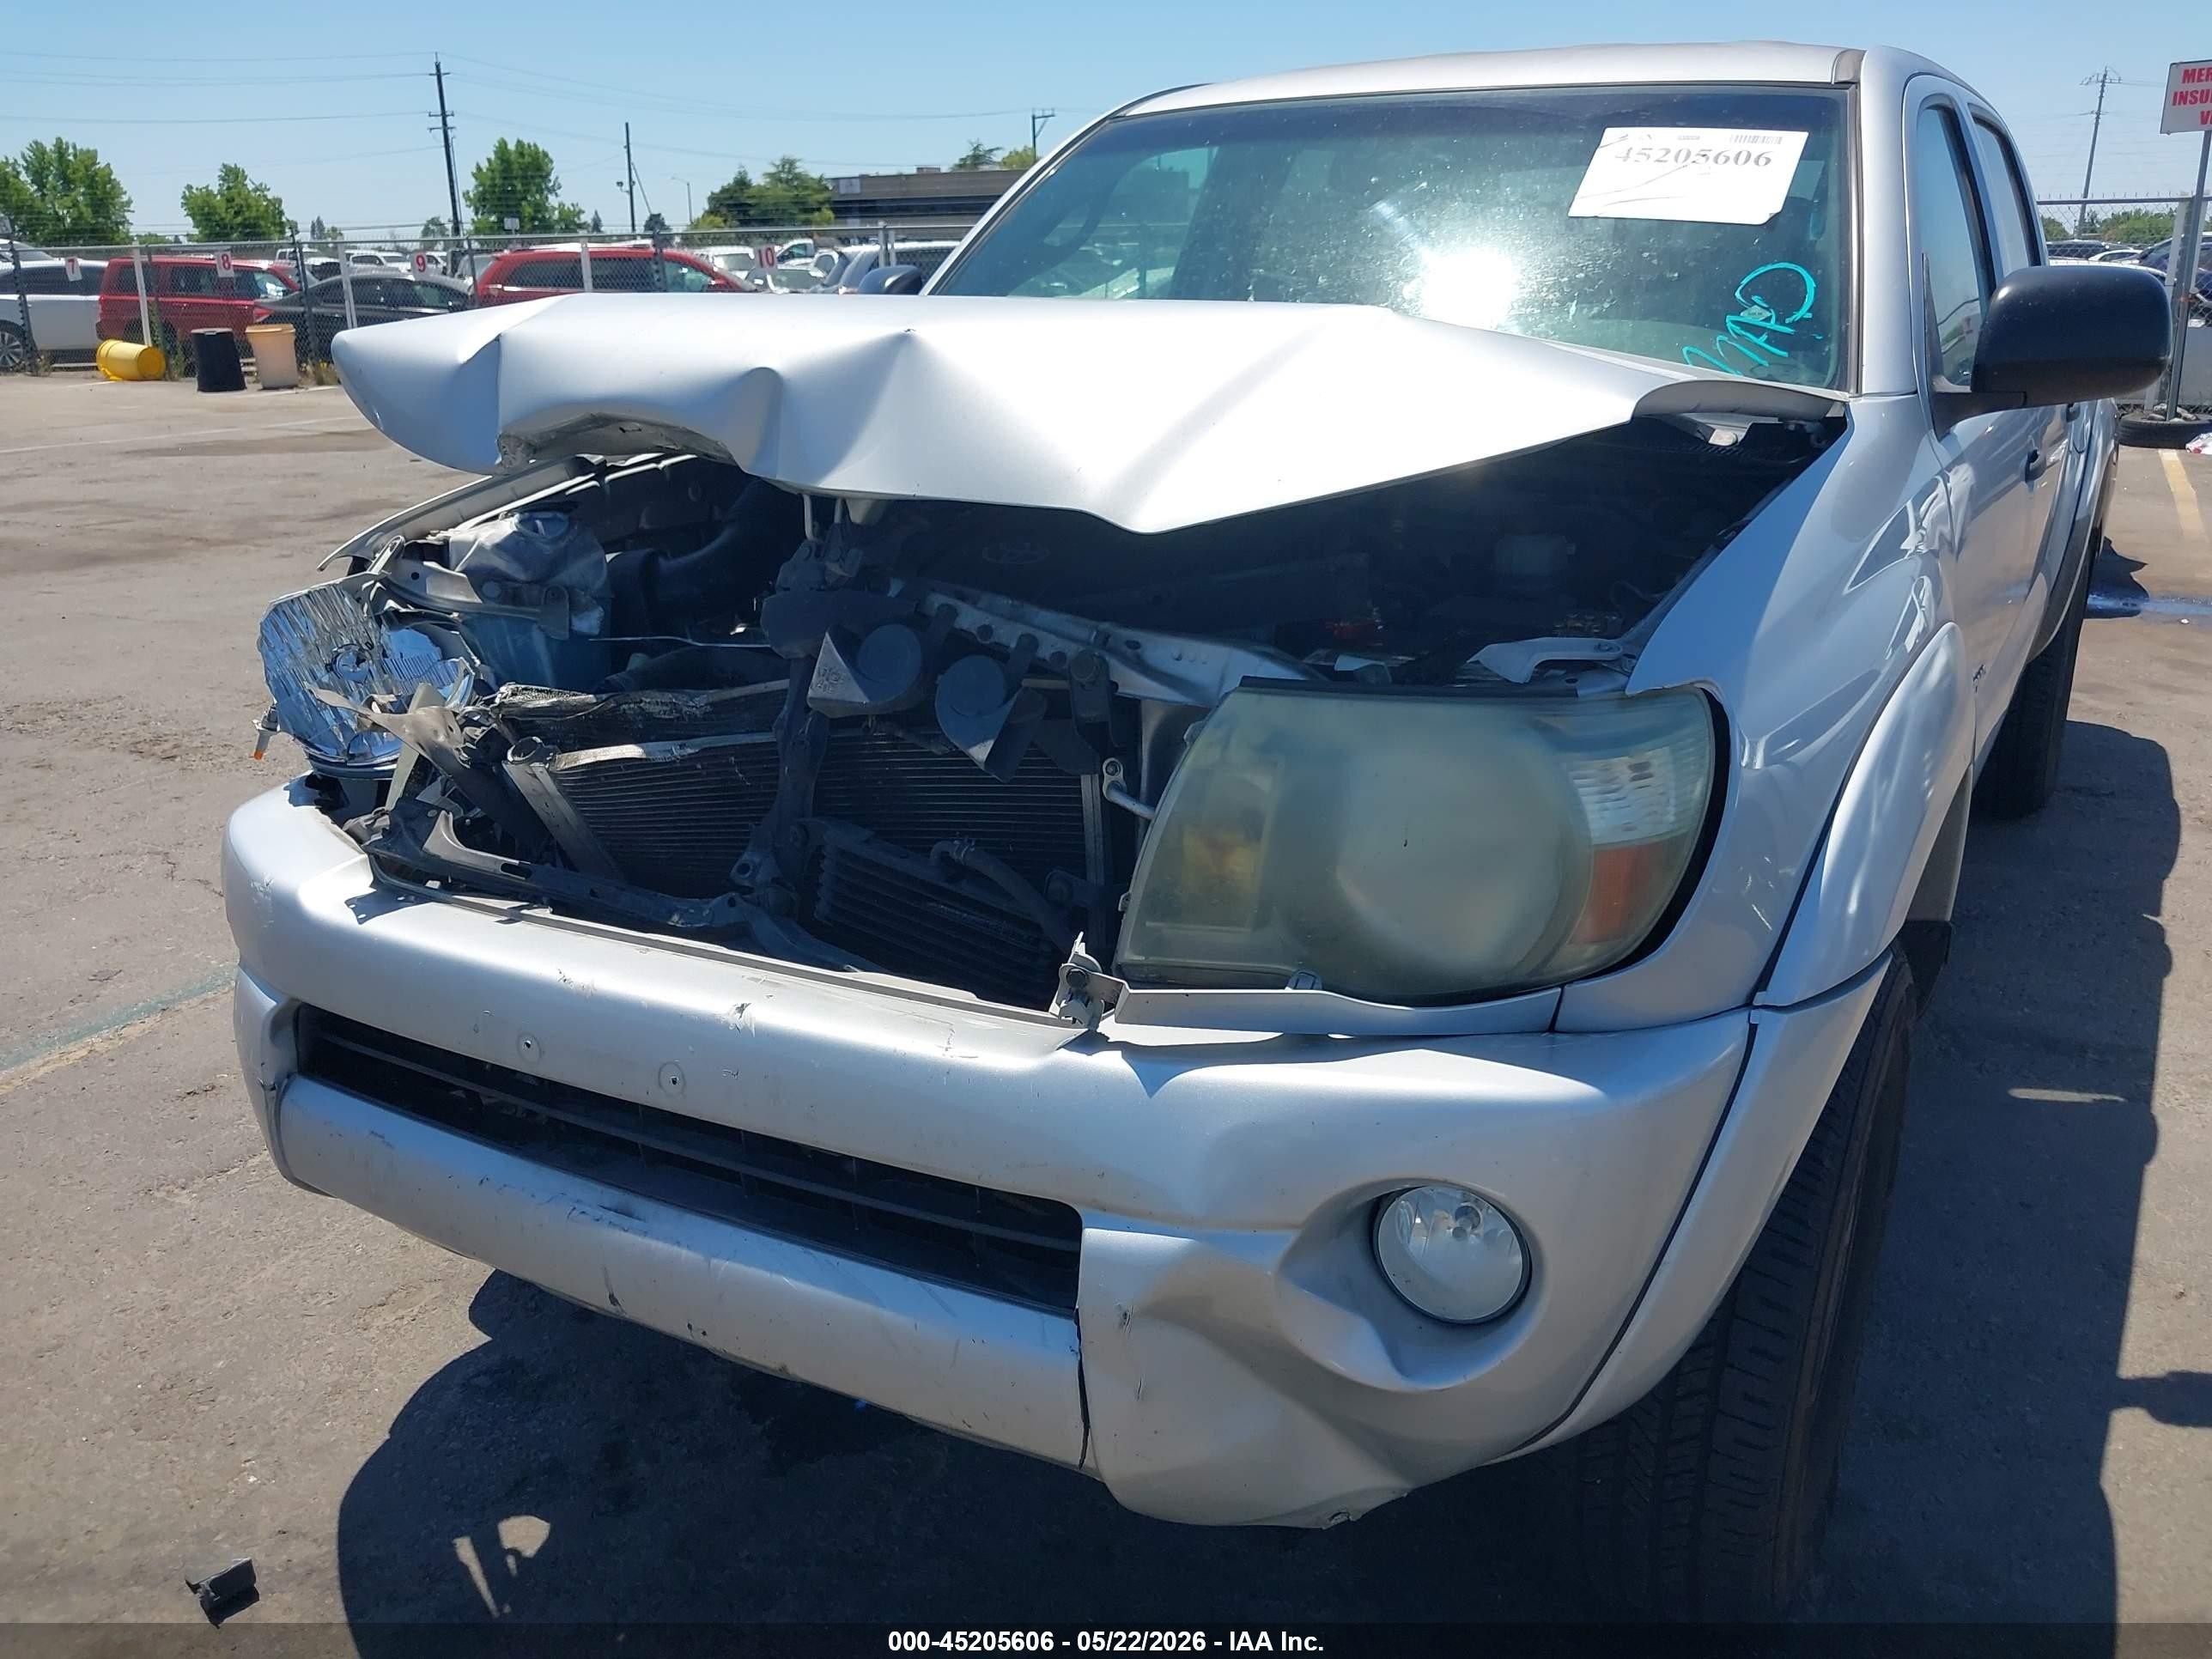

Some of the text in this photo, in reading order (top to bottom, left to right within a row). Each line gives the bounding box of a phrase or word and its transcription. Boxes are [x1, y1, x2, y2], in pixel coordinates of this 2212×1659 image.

[2172, 88, 2212, 106] INSU
[1614, 146, 1775, 167] 45205606
[67, 258, 76, 275] 7
[221, 252, 231, 270] 8
[416, 254, 427, 272] 9
[757, 247, 775, 268] 10
